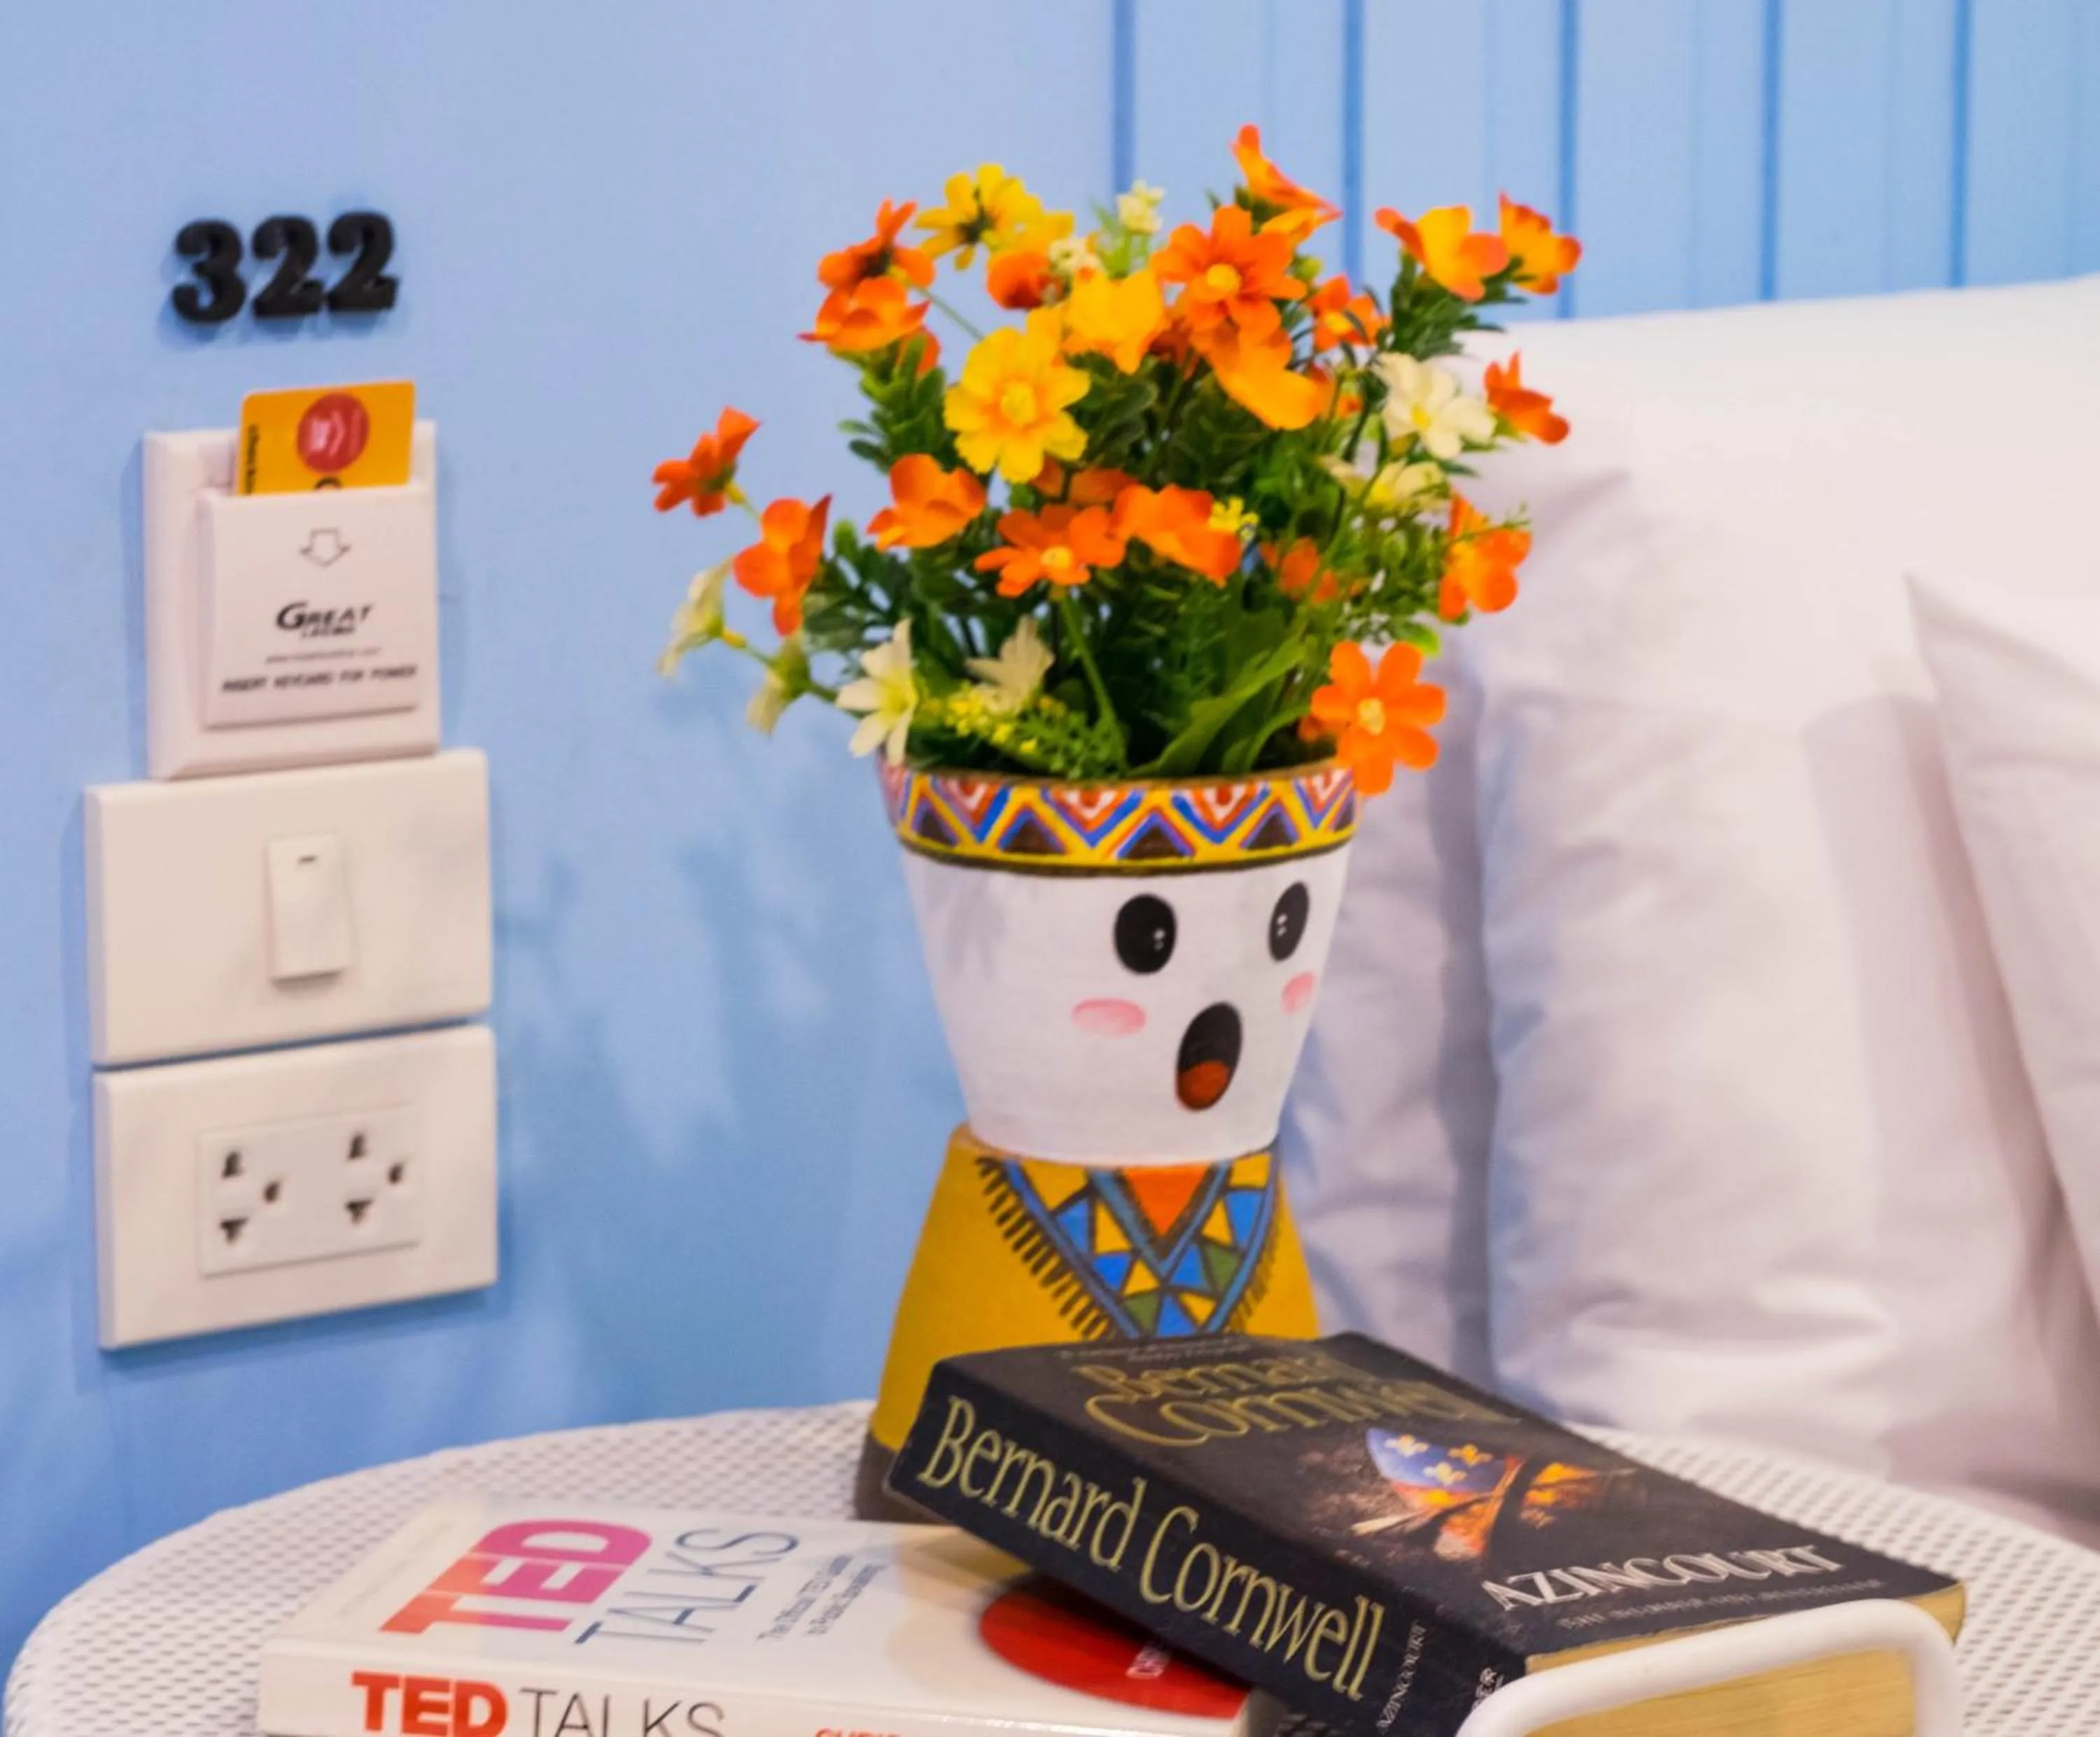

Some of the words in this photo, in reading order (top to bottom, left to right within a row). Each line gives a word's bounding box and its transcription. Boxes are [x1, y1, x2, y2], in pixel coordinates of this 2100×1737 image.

[172, 209, 399, 324] 322
[379, 1519, 653, 1634] TED
[574, 1528, 799, 1645] TALKS
[918, 1397, 1147, 1573] Bernard
[1139, 1505, 1385, 1701] Cornwell
[1480, 1545, 1844, 1612] AZINCOURT
[351, 1671, 509, 1737] TED
